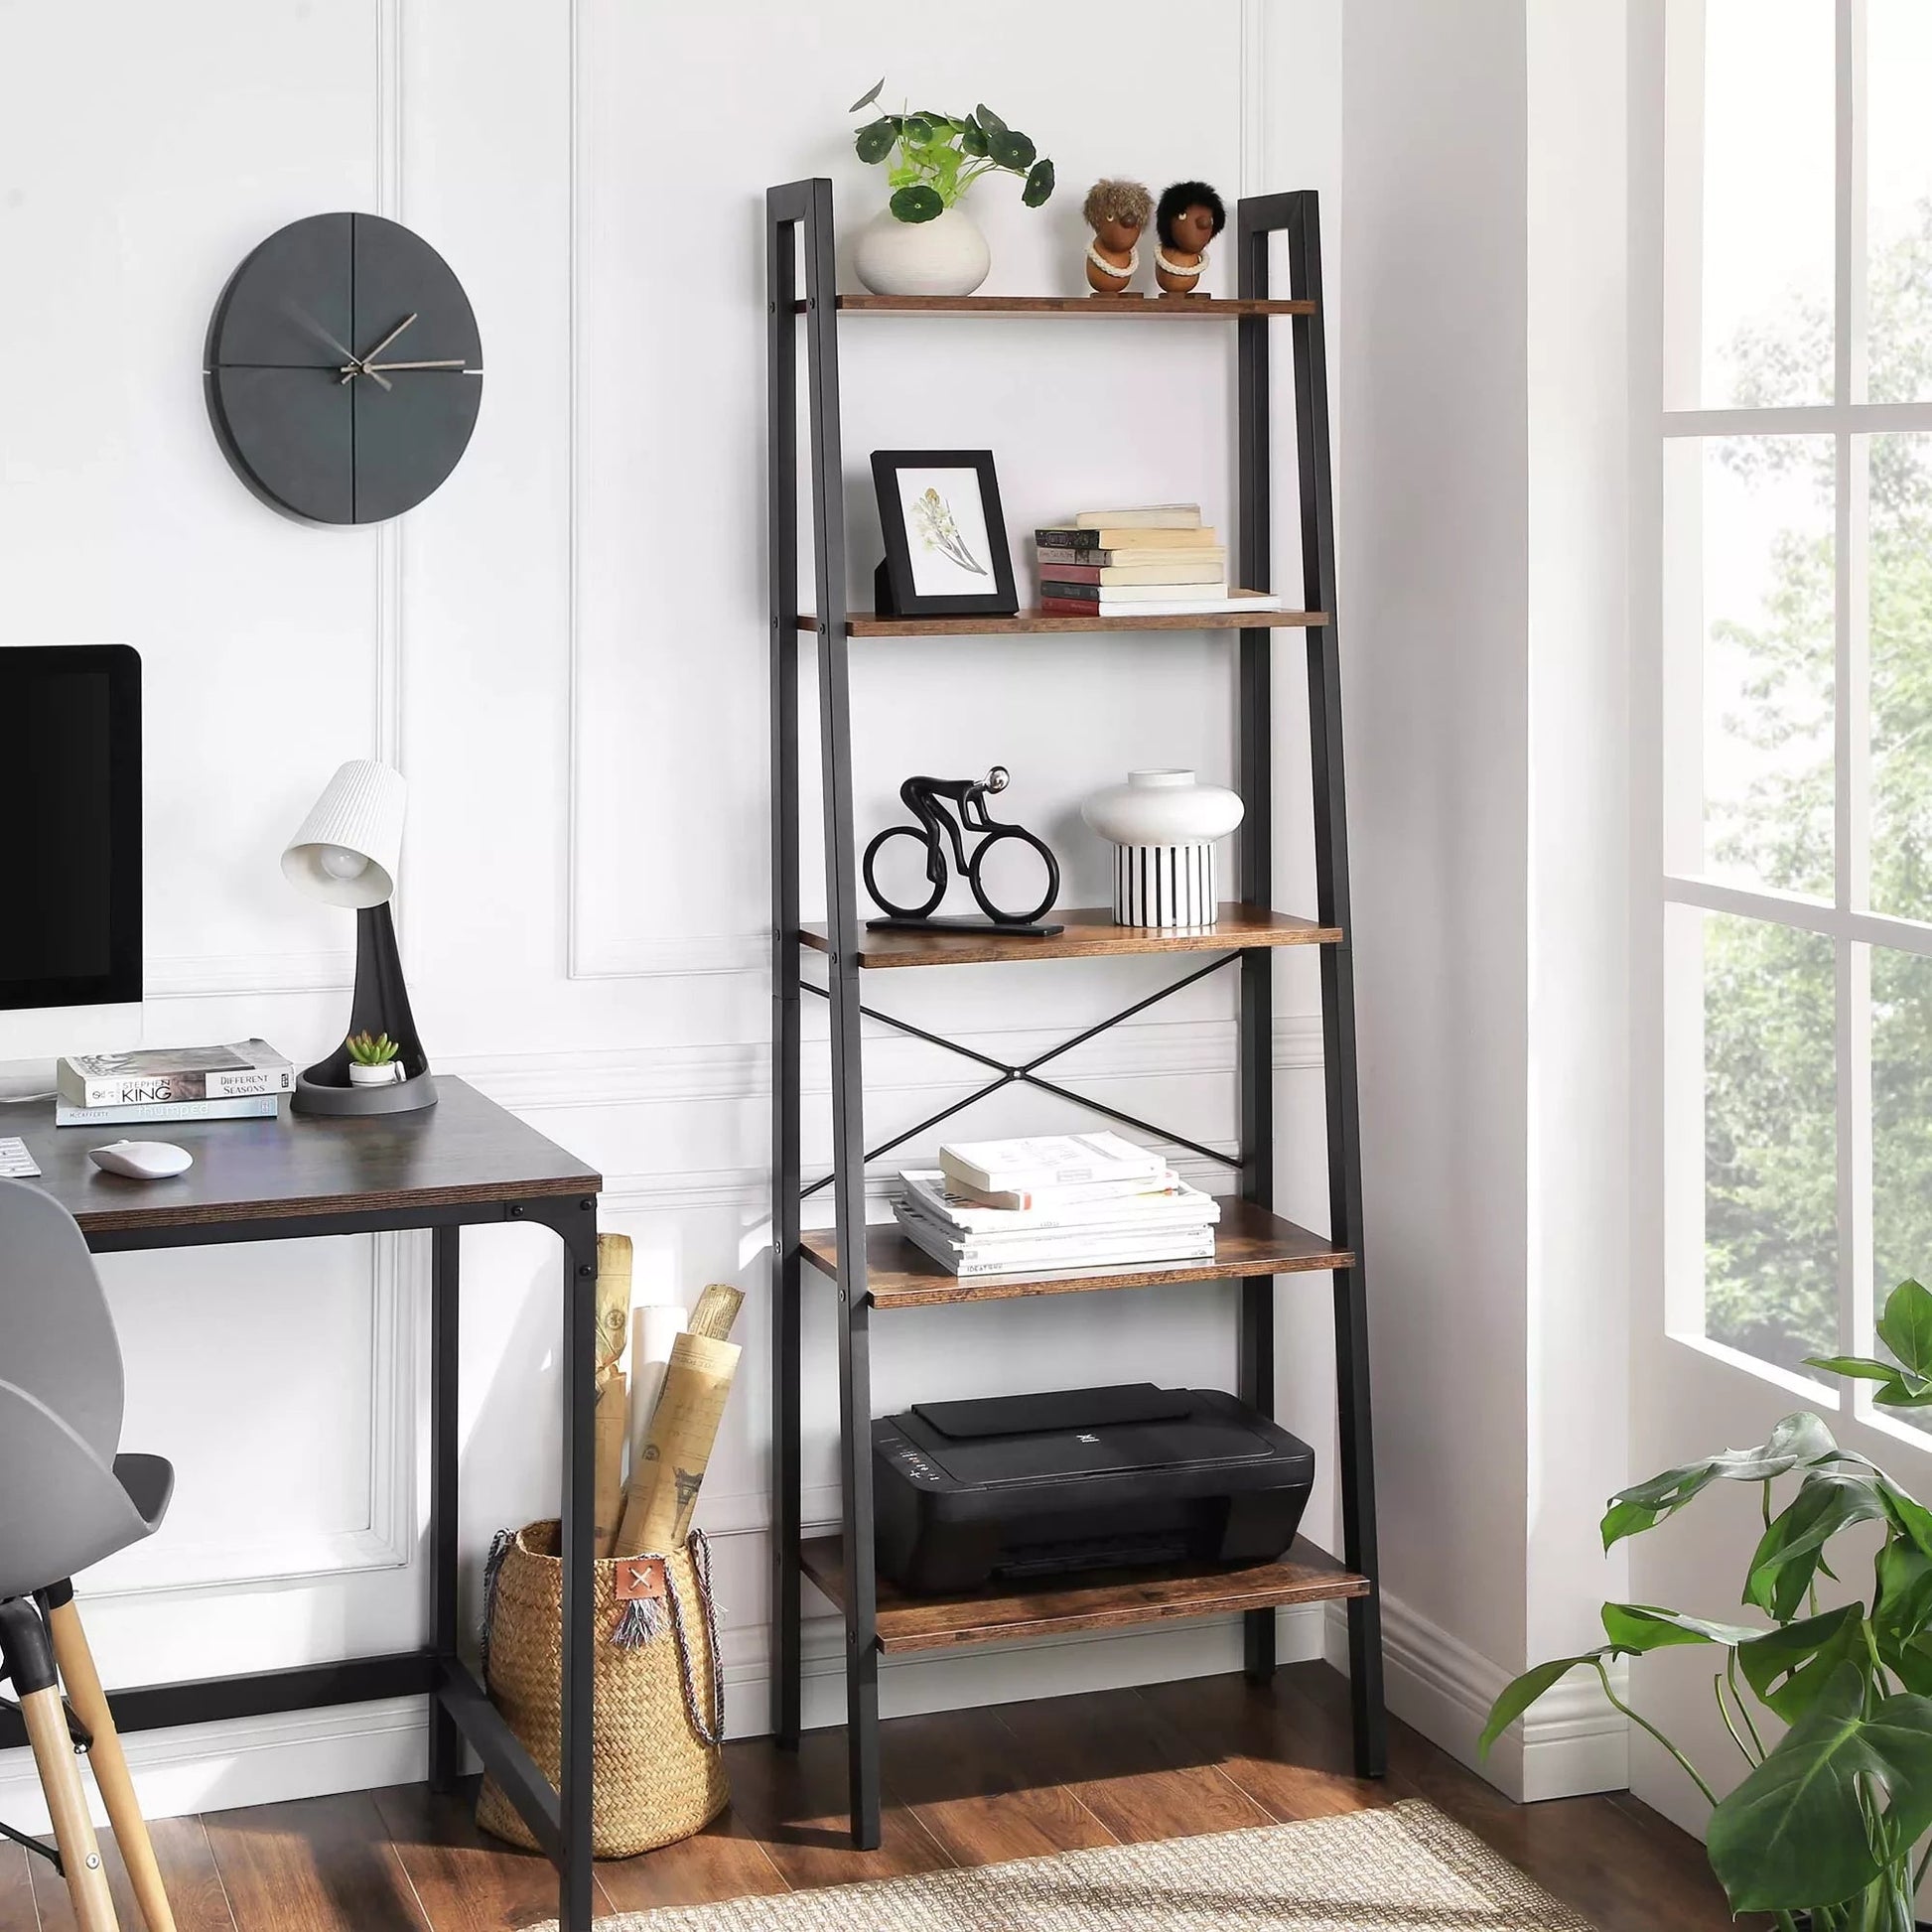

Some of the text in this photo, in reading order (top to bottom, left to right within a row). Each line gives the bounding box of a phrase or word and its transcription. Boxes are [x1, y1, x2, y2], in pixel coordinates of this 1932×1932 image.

[122, 1079, 171, 1089] STEPHEN
[220, 1074, 269, 1085] DIFFERENT
[122, 1086, 172, 1103] KING
[223, 1084, 265, 1094] SEASONS
[136, 1100, 208, 1116] thumped
